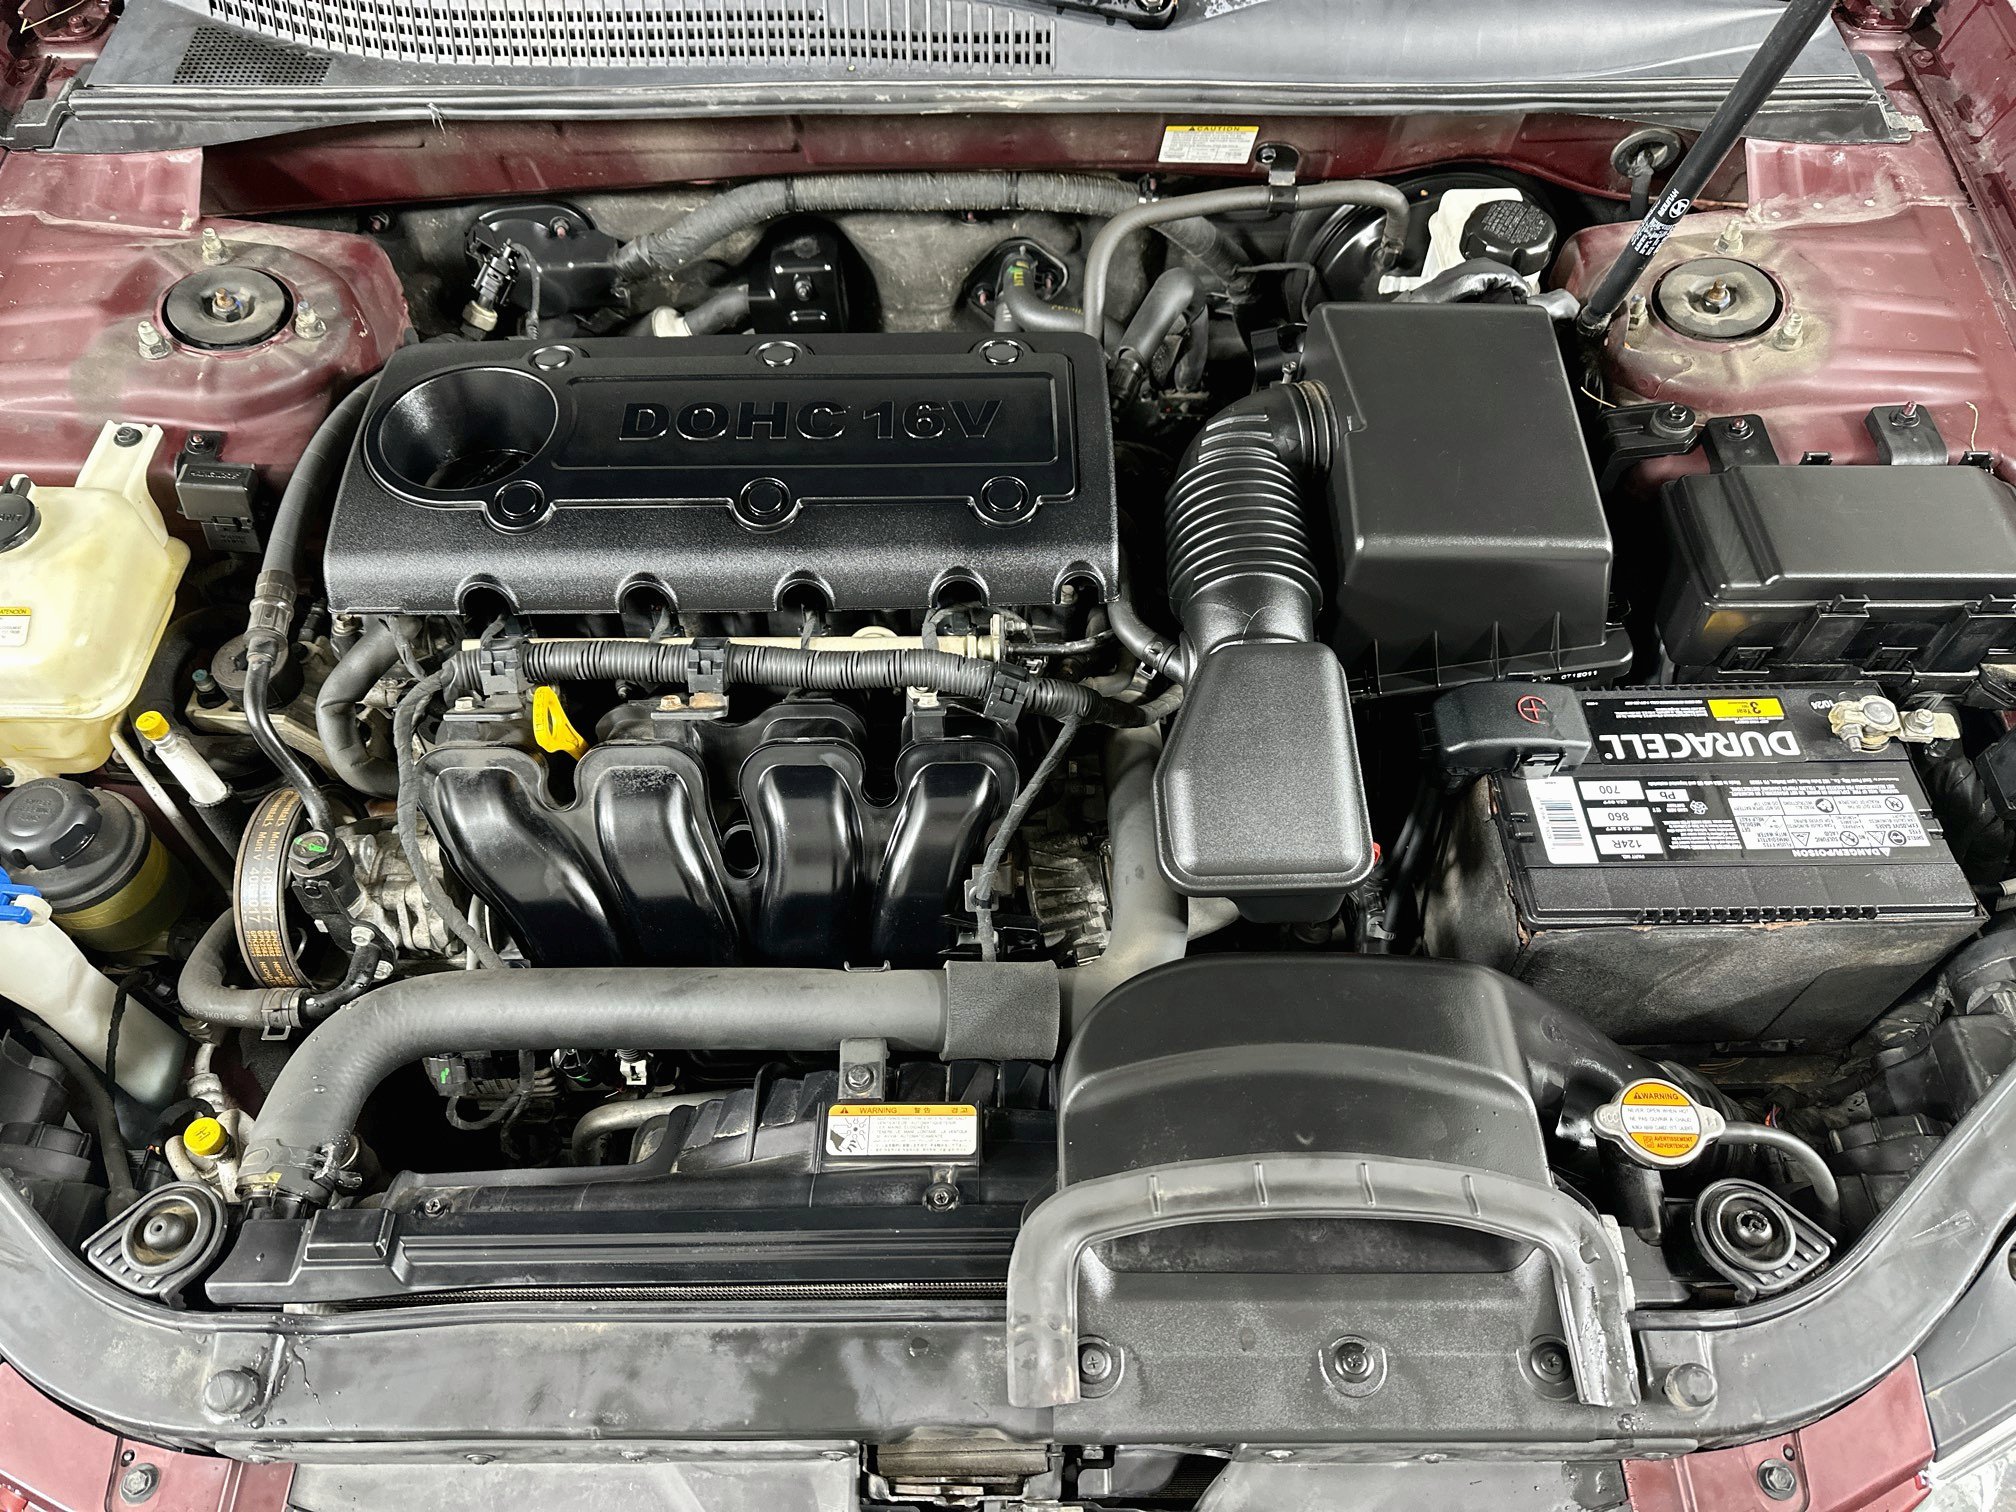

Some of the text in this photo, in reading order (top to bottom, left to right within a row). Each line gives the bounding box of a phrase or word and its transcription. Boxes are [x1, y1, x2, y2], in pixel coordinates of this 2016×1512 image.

[619, 400, 1002, 441] DOHC 16V
[1750, 702, 1761, 714] 3
[1599, 731, 1800, 759] DURACELL
[1598, 785, 1620, 794] 700
[1660, 791, 1676, 800] Pb
[1608, 812, 1629, 821] 860
[254, 832, 267, 852] Multi
[268, 832, 280, 852] Multi
[1612, 840, 1642, 848] 124R
[1791, 848, 1881, 857] DANGER/POISON
